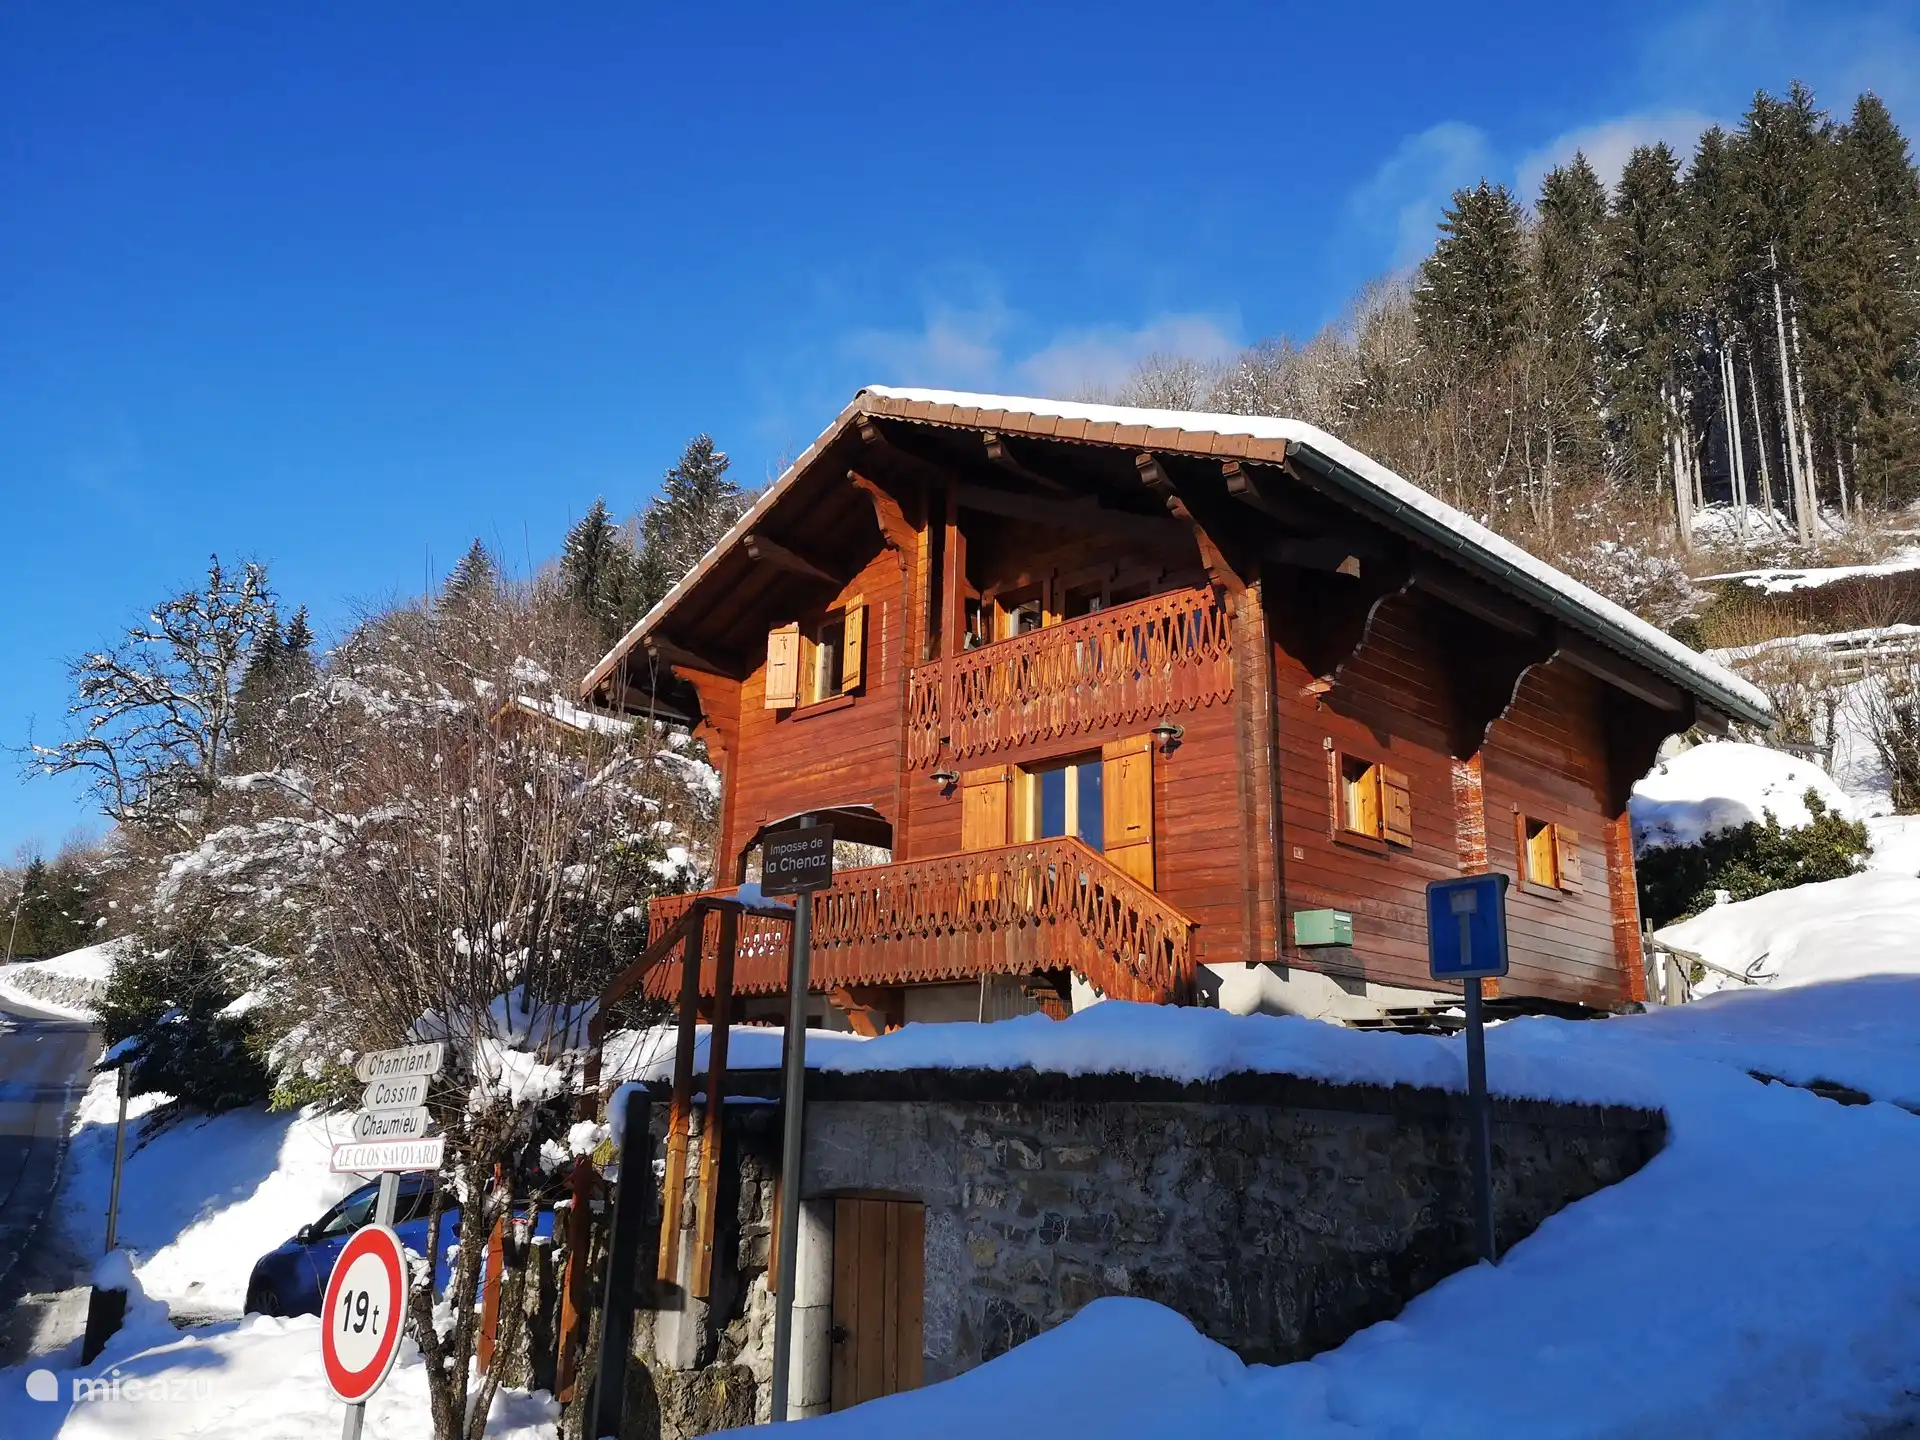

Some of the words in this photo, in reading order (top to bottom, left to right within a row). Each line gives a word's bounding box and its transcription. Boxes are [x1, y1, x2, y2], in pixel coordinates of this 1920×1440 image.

[770, 842, 808, 855] Impasse
[810, 838, 823, 848] de
[765, 861, 777, 873] la
[780, 854, 827, 871] Chenaz
[369, 1050, 431, 1076] Chanriant
[375, 1081, 417, 1104] Cossin
[362, 1113, 418, 1136] Chaumieu
[338, 1149, 352, 1167] LE
[353, 1147, 380, 1166] CLOS
[382, 1144, 438, 1165] SAVOYARD
